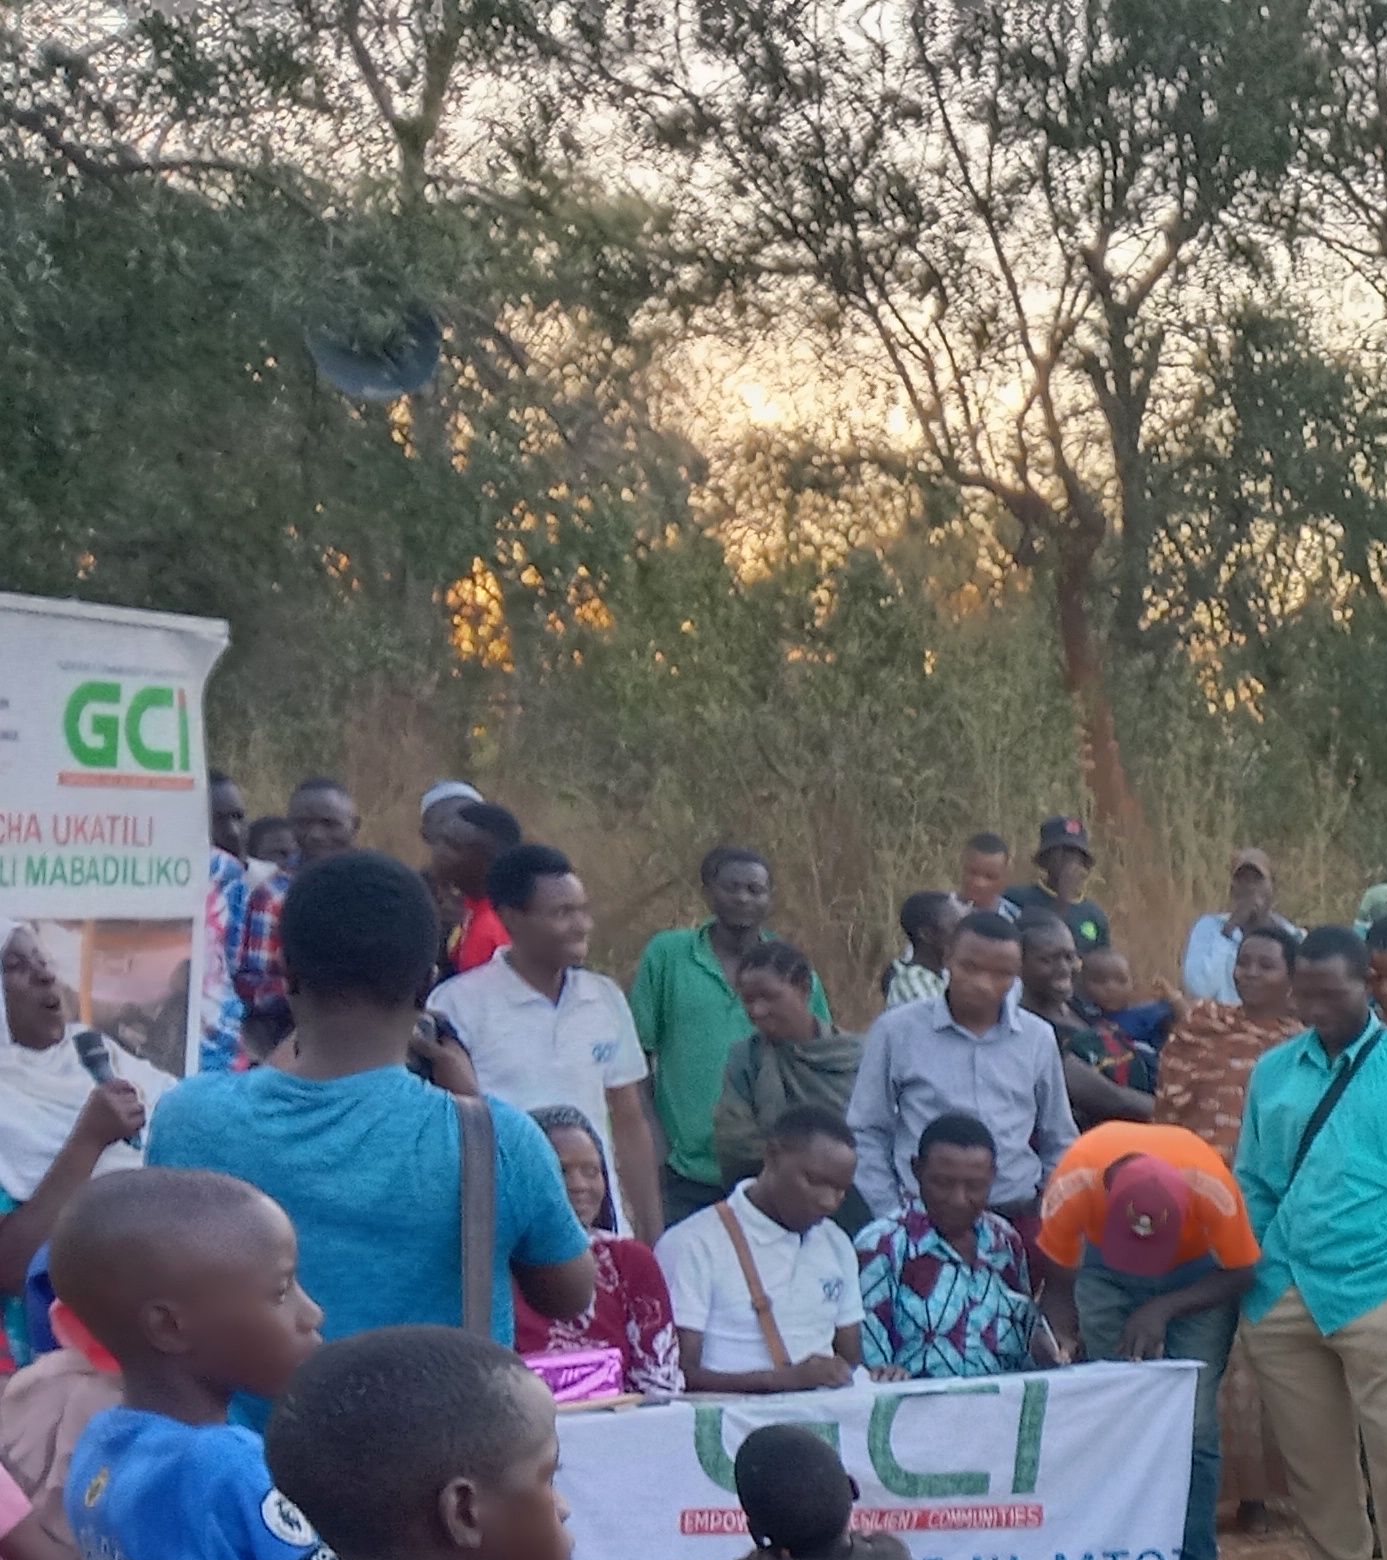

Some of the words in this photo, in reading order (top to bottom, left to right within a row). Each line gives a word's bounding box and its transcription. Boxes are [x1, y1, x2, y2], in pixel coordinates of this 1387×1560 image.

[63, 681, 191, 772] GCI
[52, 813, 153, 848] UKATILI
[25, 854, 191, 887] MABADILIKO
[928, 1504, 1042, 1530] COMMUNITIES
